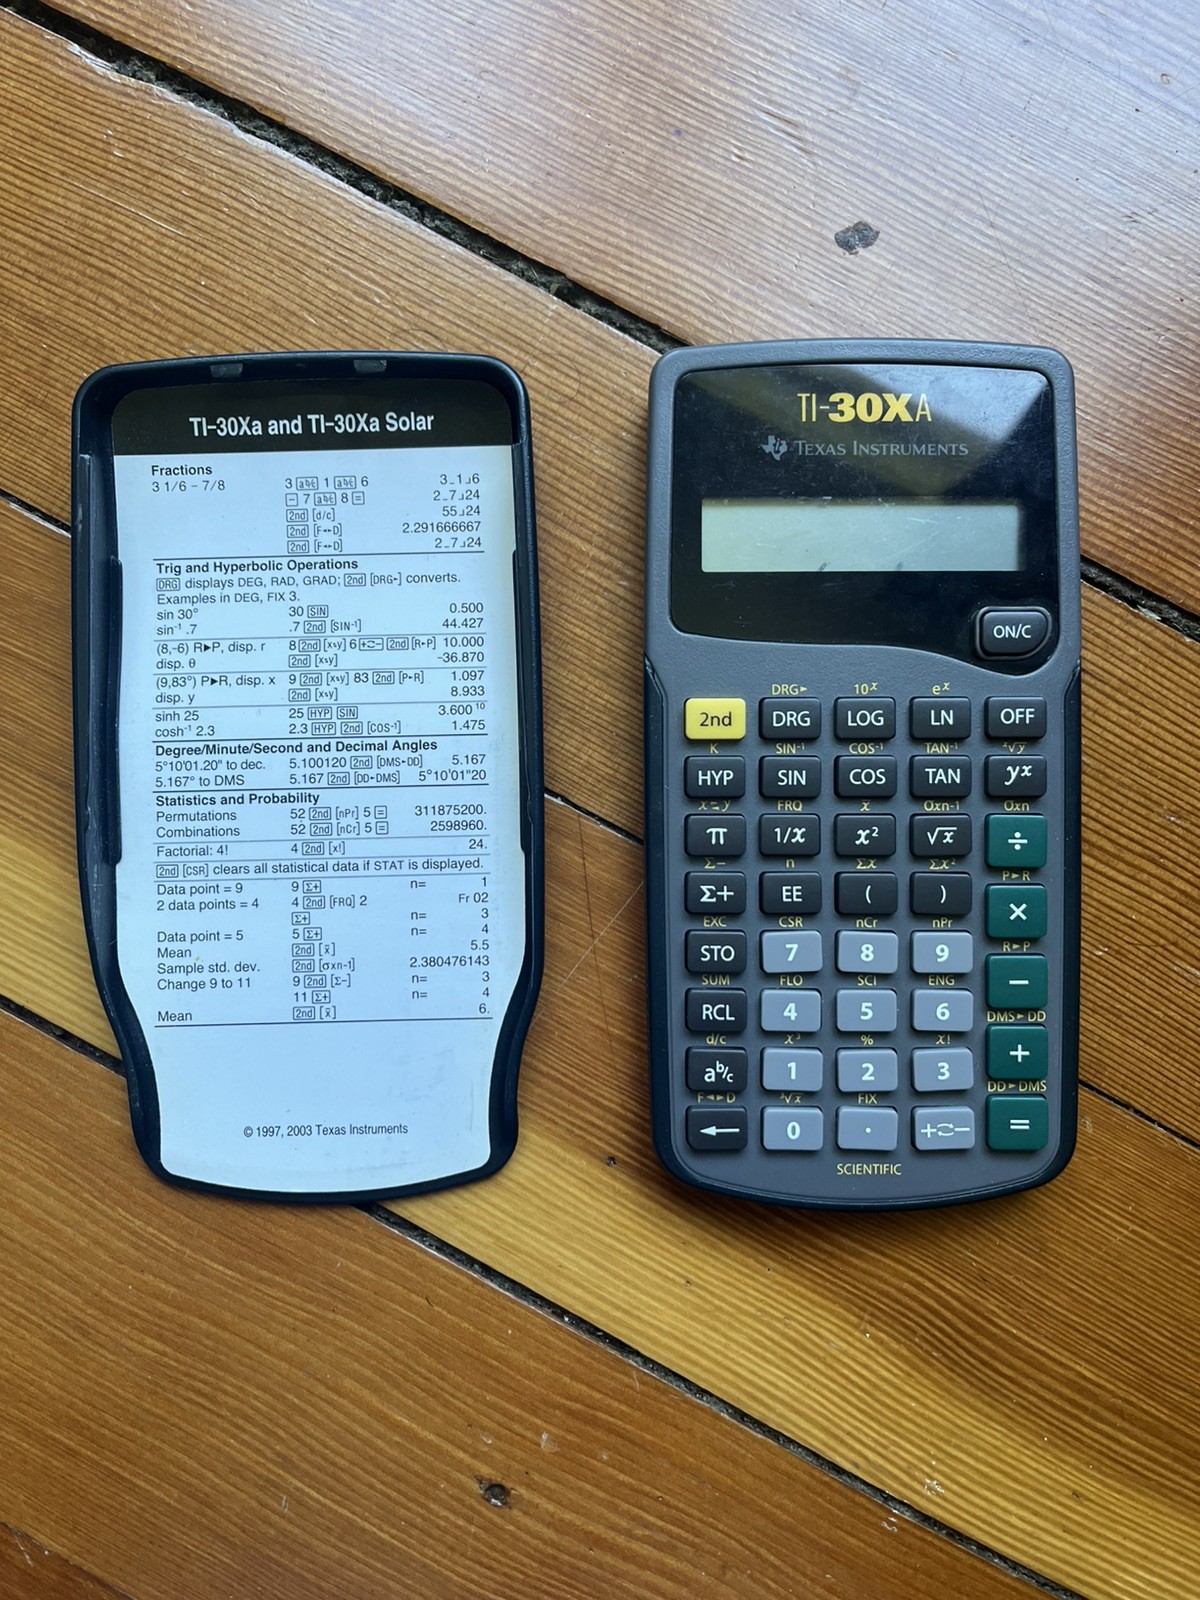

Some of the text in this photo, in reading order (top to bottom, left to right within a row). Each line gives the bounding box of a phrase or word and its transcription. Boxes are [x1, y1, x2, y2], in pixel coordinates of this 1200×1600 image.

[189, 412, 434, 436] TI-30Xa and TI-30Xa Solar
[152, 464, 212, 476] Fractions
[165, 480, 187, 492] 1/6
[202, 480, 226, 490] 7/8
[402, 521, 481, 533] 2.291666667
[156, 559, 358, 576] Trig and Hyperbolic Operations
[185, 573, 461, 591] displays DEG, RAD, GRAD; 2nd converts.
[157, 591, 300, 606] Examples in DEG, FIX 3.
[157, 608, 198, 620] sin 30°
[288, 606, 327, 617] 30 SIN
[450, 602, 484, 614] 0.500
[442, 618, 484, 628] 44.427
[993, 625, 1032, 640] ON/C
[443, 636, 484, 647] 10.000
[438, 652, 484, 662] -36.870
[156, 658, 184, 671] disp.
[452, 670, 484, 681] 1.097
[450, 686, 485, 696] 8.933
[156, 692, 184, 705] disp.
[155, 710, 200, 722] sinh 25
[288, 707, 356, 719] 25 HYP SIN
[700, 712, 732, 726] 2nd
[772, 711, 811, 726] DRG
[848, 710, 884, 726] LOG
[930, 710, 954, 726] LN
[1000, 708, 1035, 724] OFF
[288, 724, 334, 734] 2.3 HYP
[452, 720, 486, 730] 1.475
[156, 740, 438, 758] Degree/Minute/Second and Decimal Angles
[710, 743, 718, 754] K
[226, 760, 237, 770] to
[240, 760, 265, 770] dec.
[290, 757, 346, 768] 5.100120
[452, 754, 486, 765] 5.167
[156, 775, 244, 788] 5.167° to DMS
[290, 774, 324, 784] 5.167
[698, 770, 734, 786] HYP
[778, 770, 806, 785] SIN
[850, 769, 886, 784] COS
[925, 768, 960, 784] TAN
[156, 792, 319, 806] Statistics and Probability
[415, 804, 487, 816] 311875200.
[778, 800, 802, 812] FRQ
[156, 811, 236, 822] Permutations
[290, 808, 306, 819] 52
[290, 824, 306, 834] 52
[430, 820, 487, 831] 2598960.
[156, 826, 240, 838] Combinations
[157, 845, 228, 856] Factorial: 4!
[469, 839, 487, 850] 24.
[158, 866, 177, 876] 2nd
[213, 864, 250, 874] clears
[254, 863, 268, 874] all
[272, 862, 328, 873] statistical
[332, 861, 359, 872] data
[364, 860, 370, 871] if
[374, 860, 404, 870] STAT
[408, 860, 418, 870] is
[422, 858, 483, 872] displayed.
[157, 883, 242, 896] Data point 9
[782, 886, 802, 902] EE
[458, 892, 488, 902] Fr 02
[157, 898, 259, 912] 2 data points 4
[703, 916, 727, 928] EXC
[778, 916, 804, 928] CSR
[856, 918, 878, 928] nCr
[932, 918, 953, 928] nPr
[157, 930, 244, 944] Data point 5
[470, 940, 490, 950] 5.5
[157, 948, 192, 958] Mean
[700, 946, 735, 961] STO
[786, 944, 798, 961] 7
[860, 944, 874, 961] 8
[936, 944, 950, 962] 9
[410, 955, 490, 968] 2.380476143
[157, 962, 260, 975] Sample std. dev.
[157, 978, 250, 992] Change 9 to 11
[702, 975, 730, 985] SUM
[780, 975, 804, 986] FLO
[857, 975, 876, 986] SCI
[928, 975, 955, 986] ENG
[158, 1011, 192, 1022] Mean
[702, 1004, 736, 1020] RCL
[784, 1002, 798, 1020] 4
[860, 1002, 873, 1020] 5
[936, 1002, 950, 1020] 6
[706, 1034, 726, 1045] d/c
[861, 1035, 874, 1045] %
[788, 1062, 796, 1080] 1
[862, 1063, 874, 1080] 2
[937, 1062, 950, 1080] 3
[858, 1094, 878, 1104] FIX
[244, 1124, 408, 1138] © 1997, 2003 Texas Instruments
[787, 1122, 800, 1140] 0
[837, 1164, 902, 1175] SCIENTIFIC
